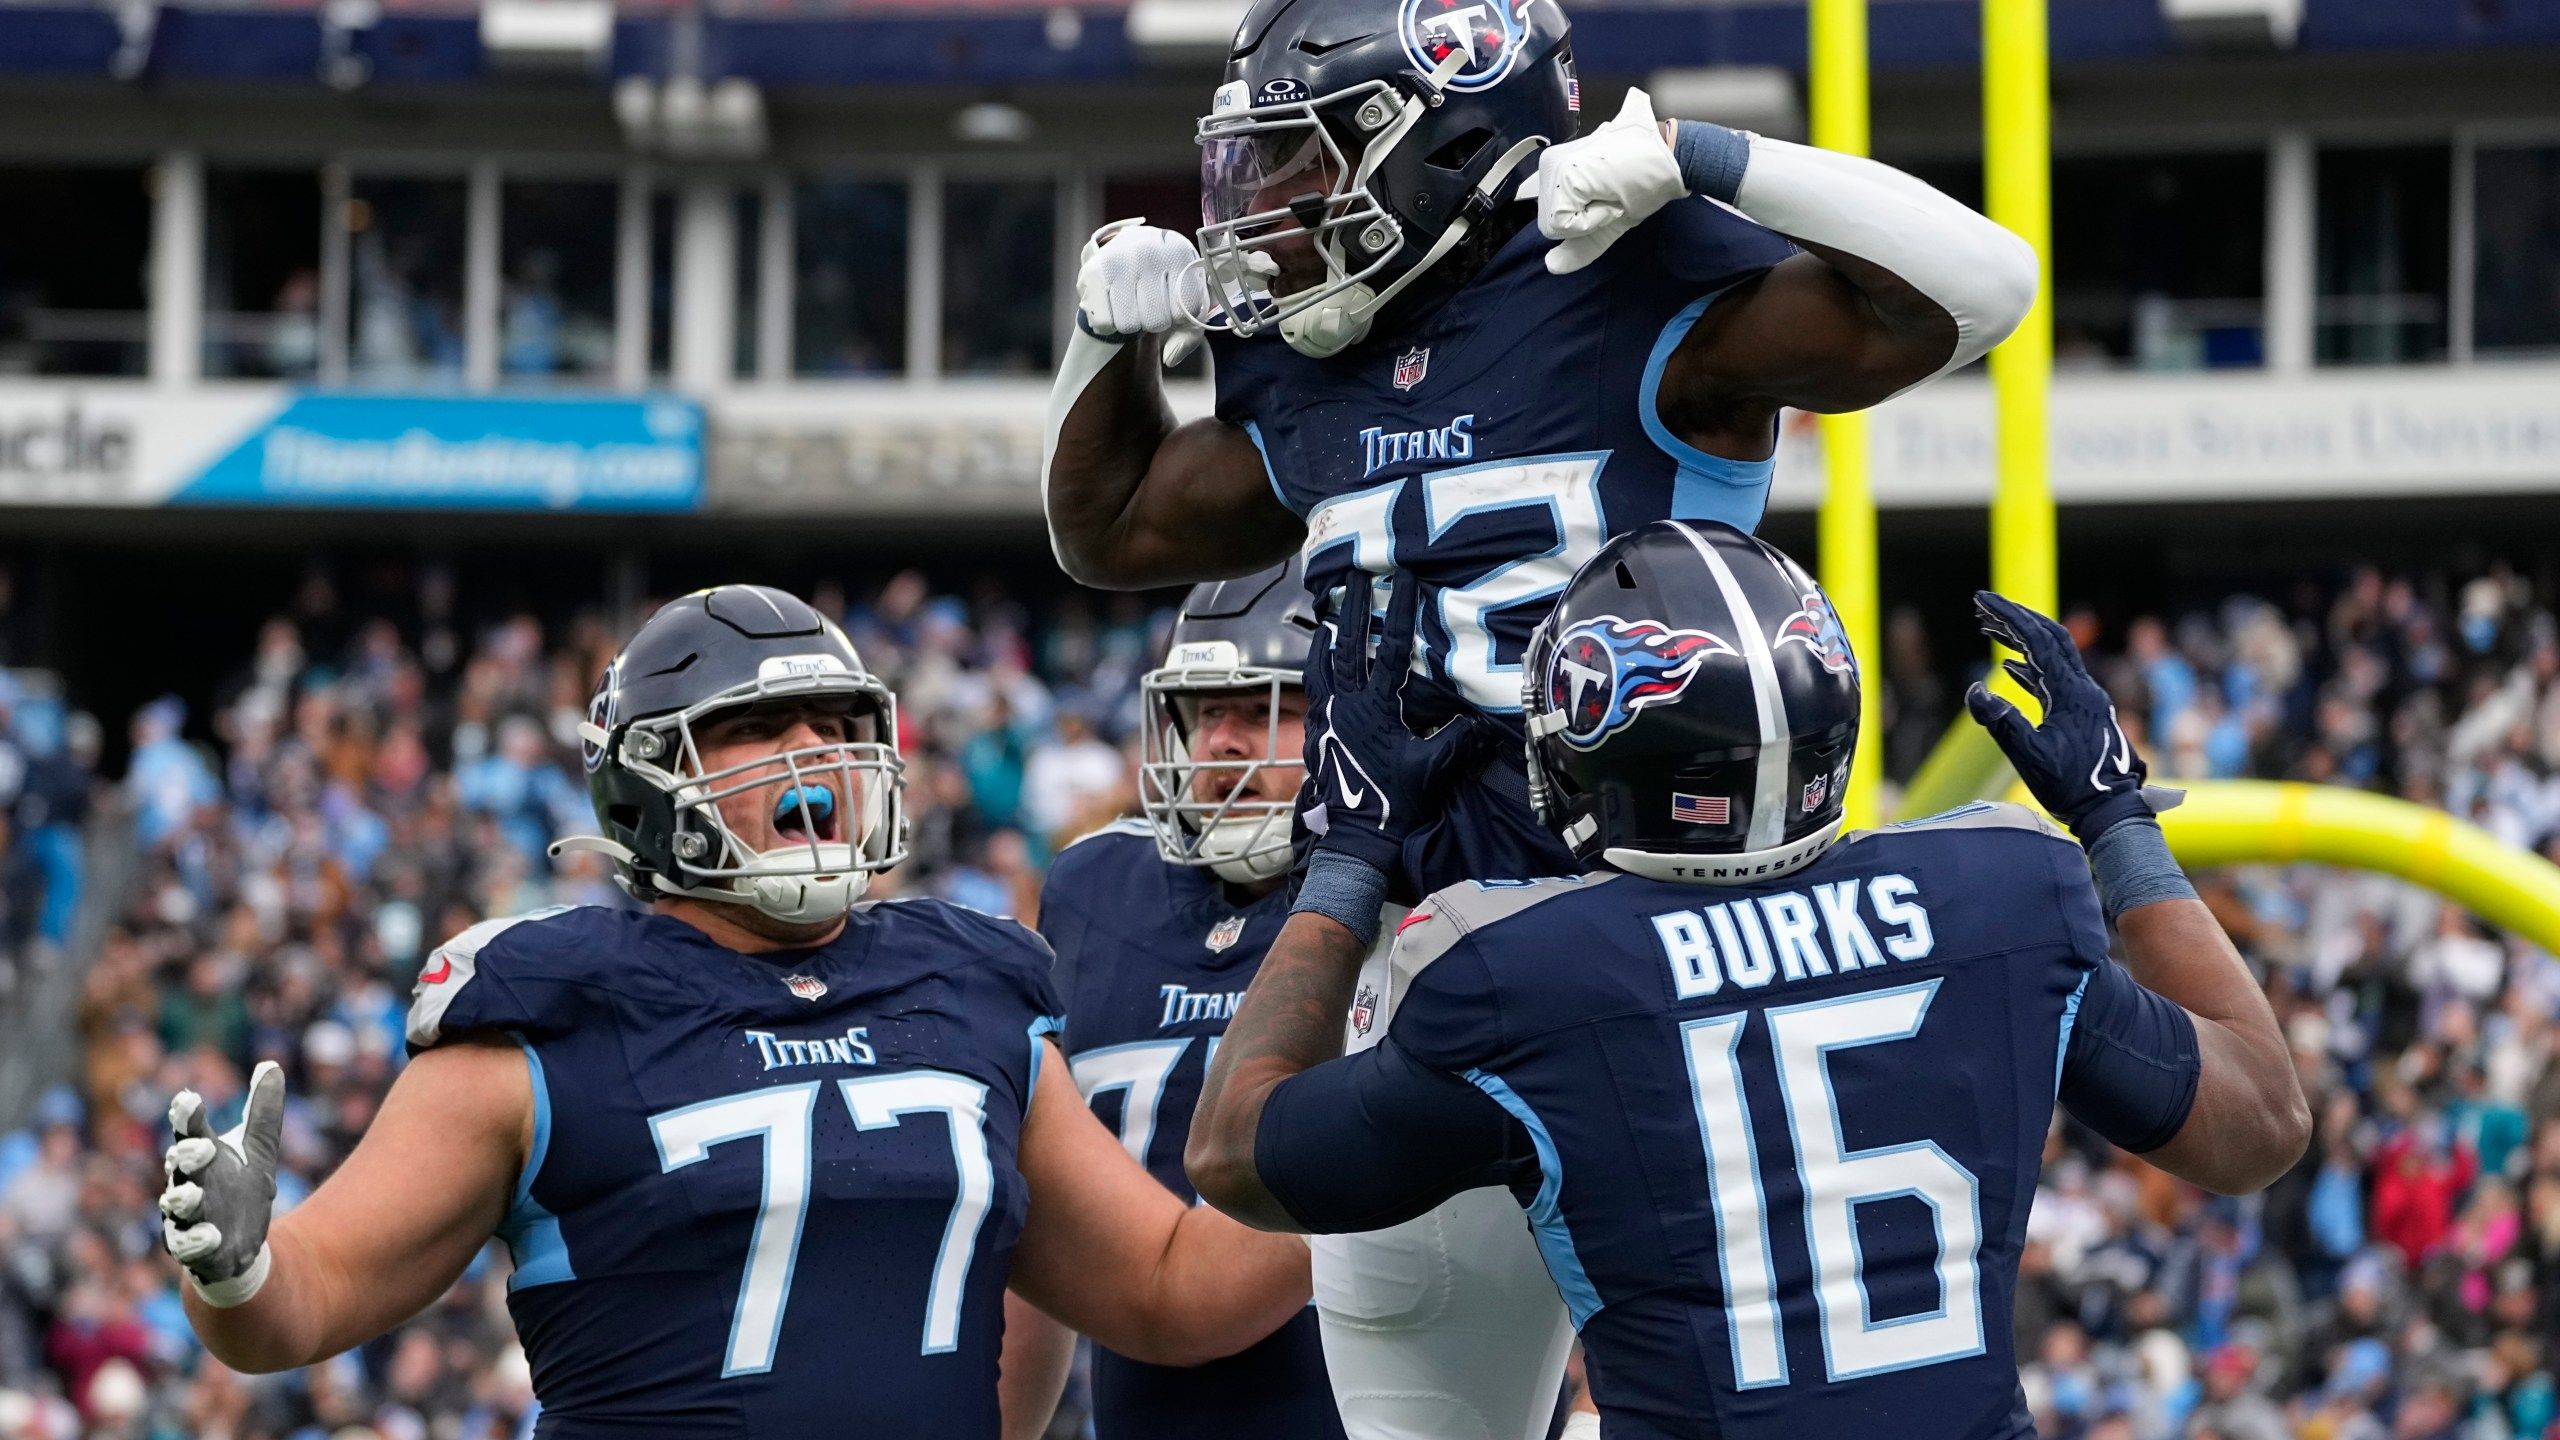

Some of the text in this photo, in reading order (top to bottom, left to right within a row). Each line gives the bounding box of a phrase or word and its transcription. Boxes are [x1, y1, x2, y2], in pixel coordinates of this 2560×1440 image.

[1258, 92, 1306, 103] OAKLEY
[1397, 363, 1424, 384] NFL
[1360, 413, 1474, 478] TITANS
[781, 659, 828, 673] TITANS
[1181, 647, 1215, 664] TITANS
[1672, 838, 1828, 878] TENNESSEE
[1650, 873, 1936, 1001] BURKS
[1159, 985, 1247, 1028] TITAN
[745, 1026, 877, 1071] TITANS
[1678, 976, 1988, 1392] 16
[646, 1069, 995, 1380] 77
